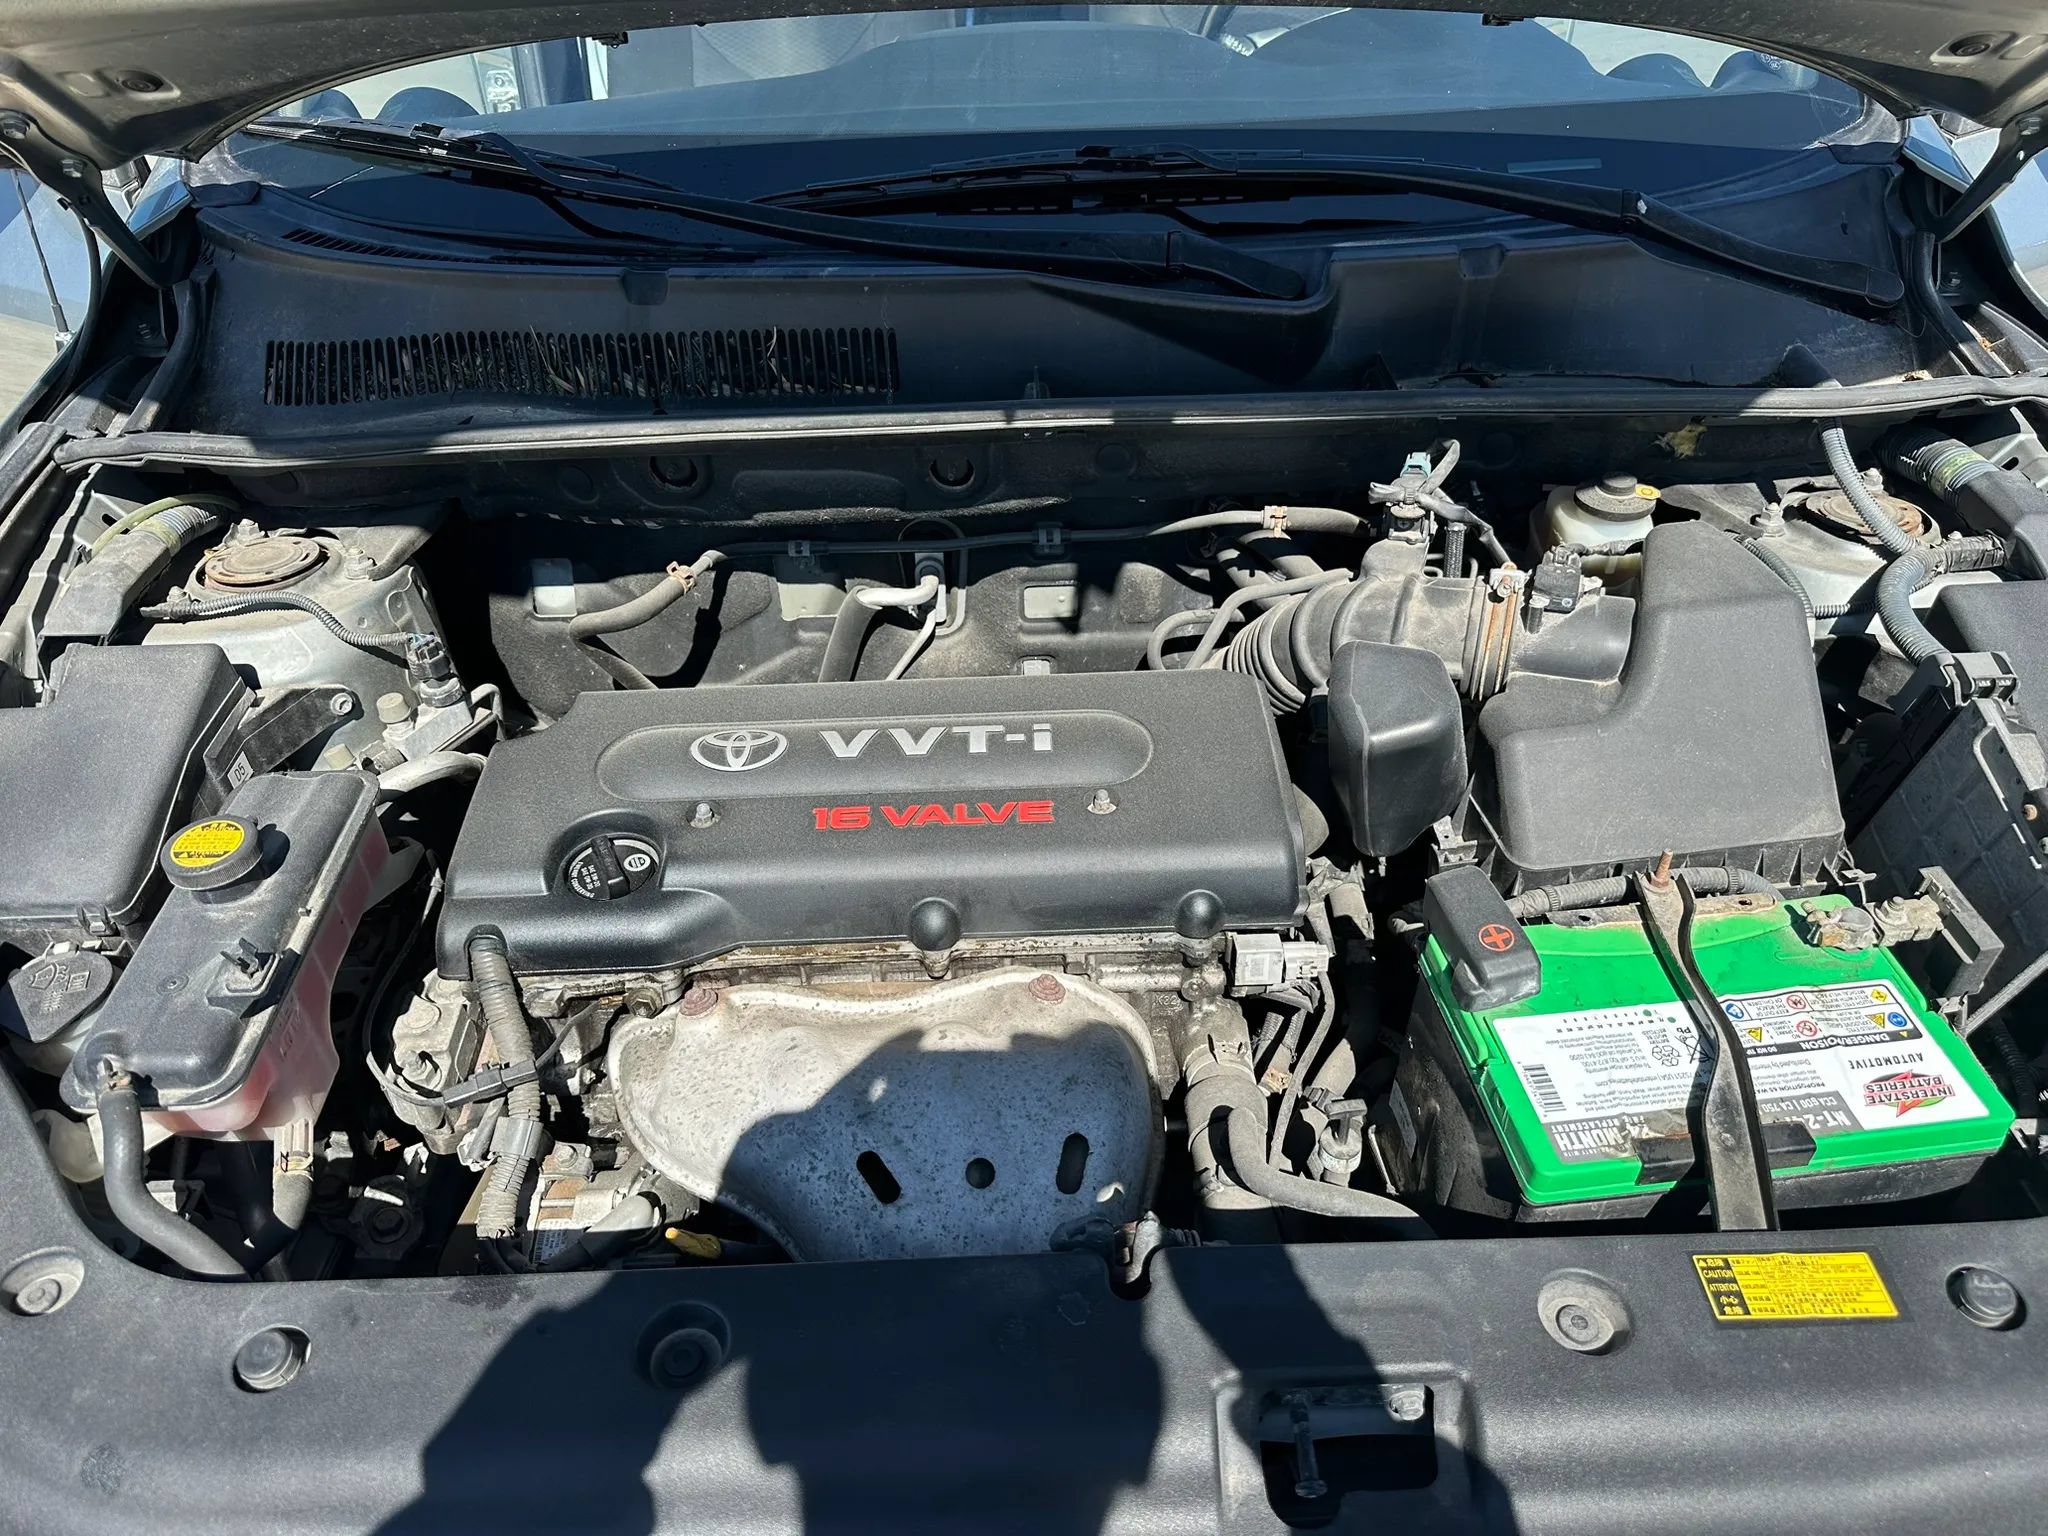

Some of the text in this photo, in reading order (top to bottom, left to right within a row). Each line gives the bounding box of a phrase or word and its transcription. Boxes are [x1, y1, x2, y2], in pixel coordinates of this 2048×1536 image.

[819, 723, 1052, 758] VVT-i
[813, 800, 1054, 829] 16 VALVE
[1848, 1052, 1923, 1070] AUTOMOTIVE
[1779, 1082, 1825, 1092] PROPOSITION
[1866, 1076, 1942, 1093] BATTERIES
[1817, 1096, 1837, 1106] CCA
[1866, 1086, 1952, 1104] INTERSTATE
[1761, 1103, 1780, 1113] 750
[1779, 1101, 1793, 1110] CA
[1551, 1118, 1620, 1133] REPLACEMENT
[1703, 1269, 1735, 1278] CAUTION
[1709, 1283, 1740, 1292] ATTENTION
